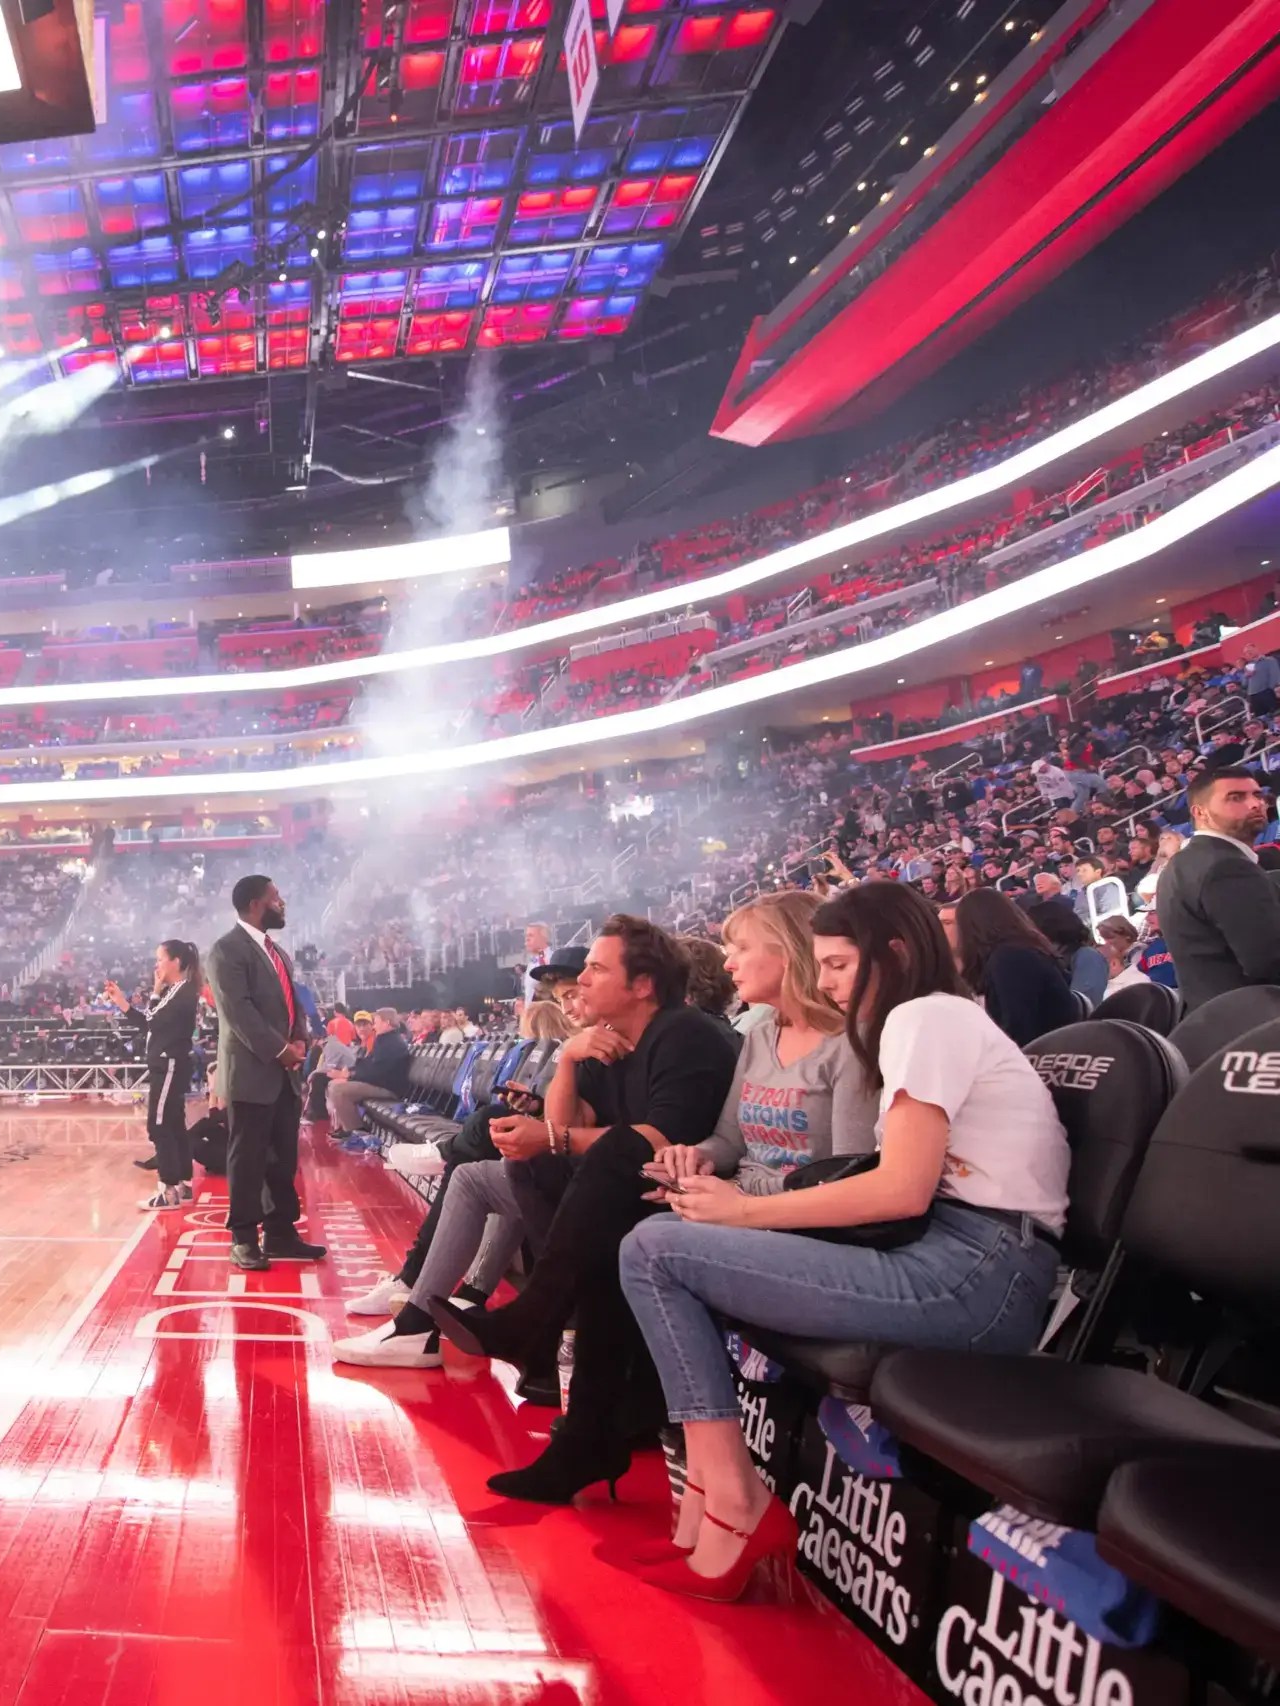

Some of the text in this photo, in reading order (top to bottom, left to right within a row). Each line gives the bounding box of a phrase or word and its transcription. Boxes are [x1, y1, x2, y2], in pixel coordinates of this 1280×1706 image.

[1037, 1070, 1100, 1090] EXUS
[316, 1200, 388, 1298] ASKETBALL
[736, 1381, 776, 1463] ttle
[815, 1440, 907, 1568] Little
[789, 1482, 912, 1646] Caesars
[935, 1604, 1046, 1706] Cae
[977, 1569, 1134, 1706] Little
